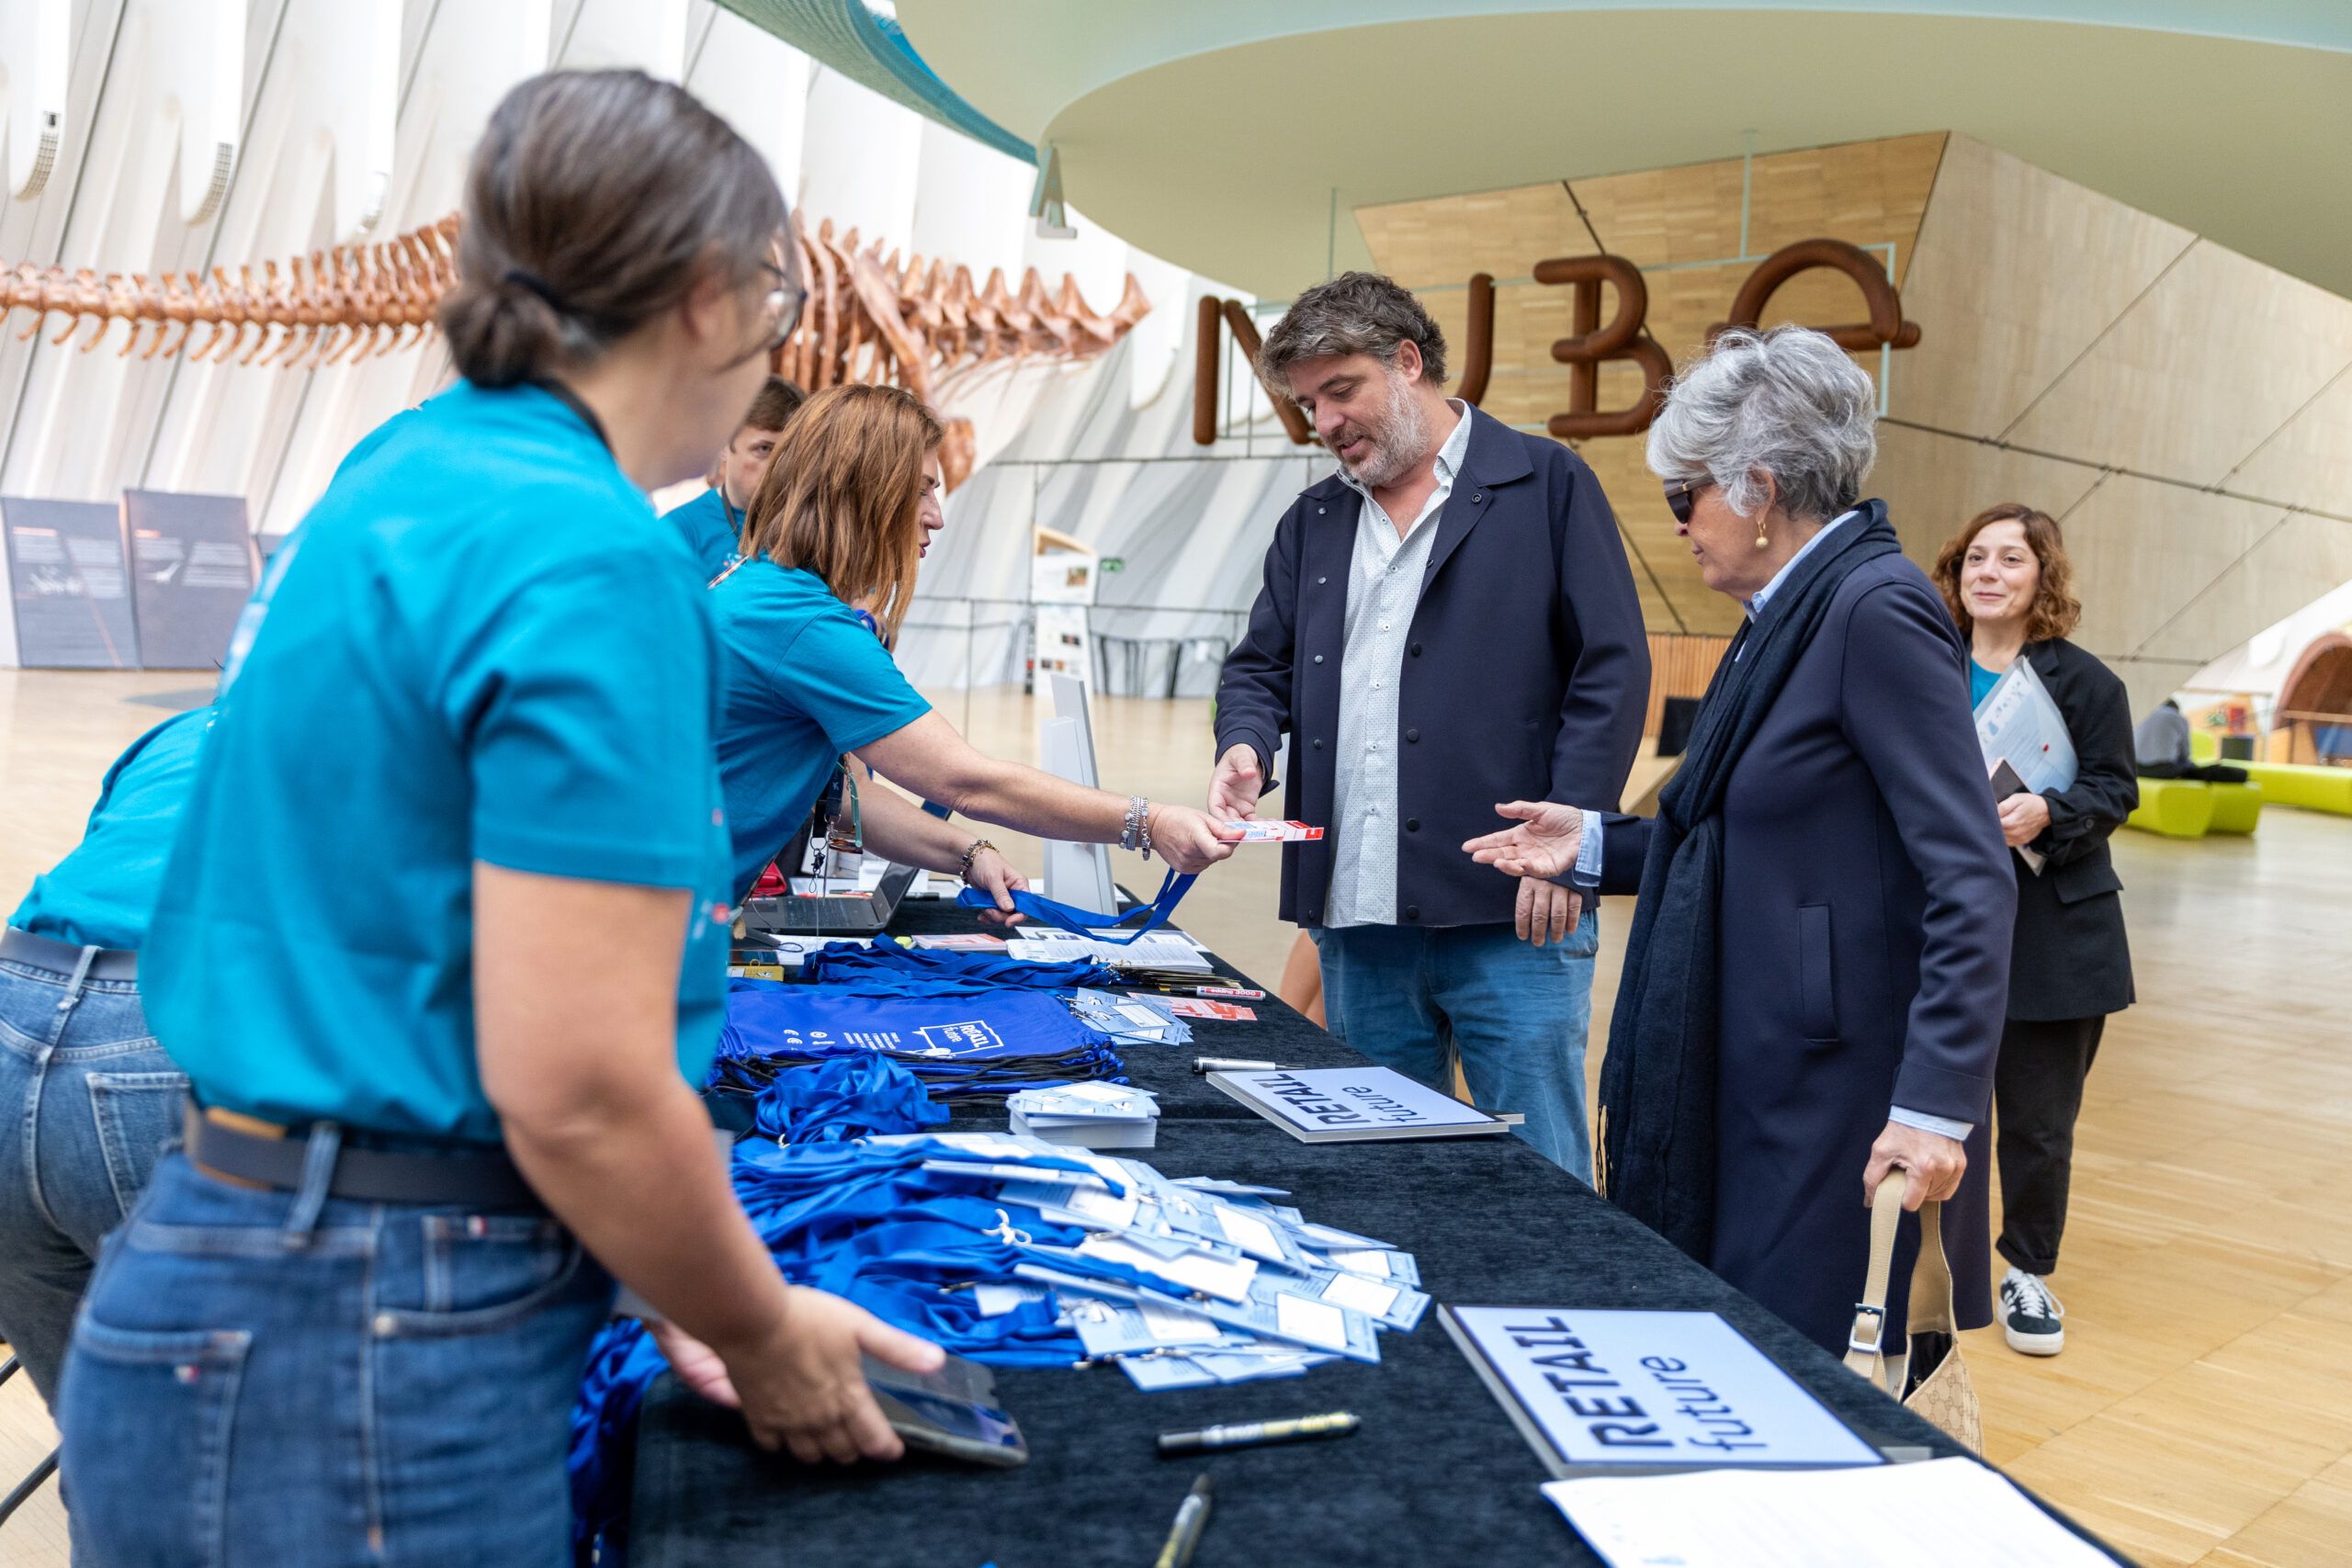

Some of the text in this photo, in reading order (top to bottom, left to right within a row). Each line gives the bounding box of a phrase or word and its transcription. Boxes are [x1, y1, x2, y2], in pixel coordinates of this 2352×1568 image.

[1251, 1074, 1372, 1124] RETAIL
[1342, 1086, 1428, 1122] future
[1503, 1316, 1676, 1448] RETAIL
[1639, 1356, 1768, 1451] future
